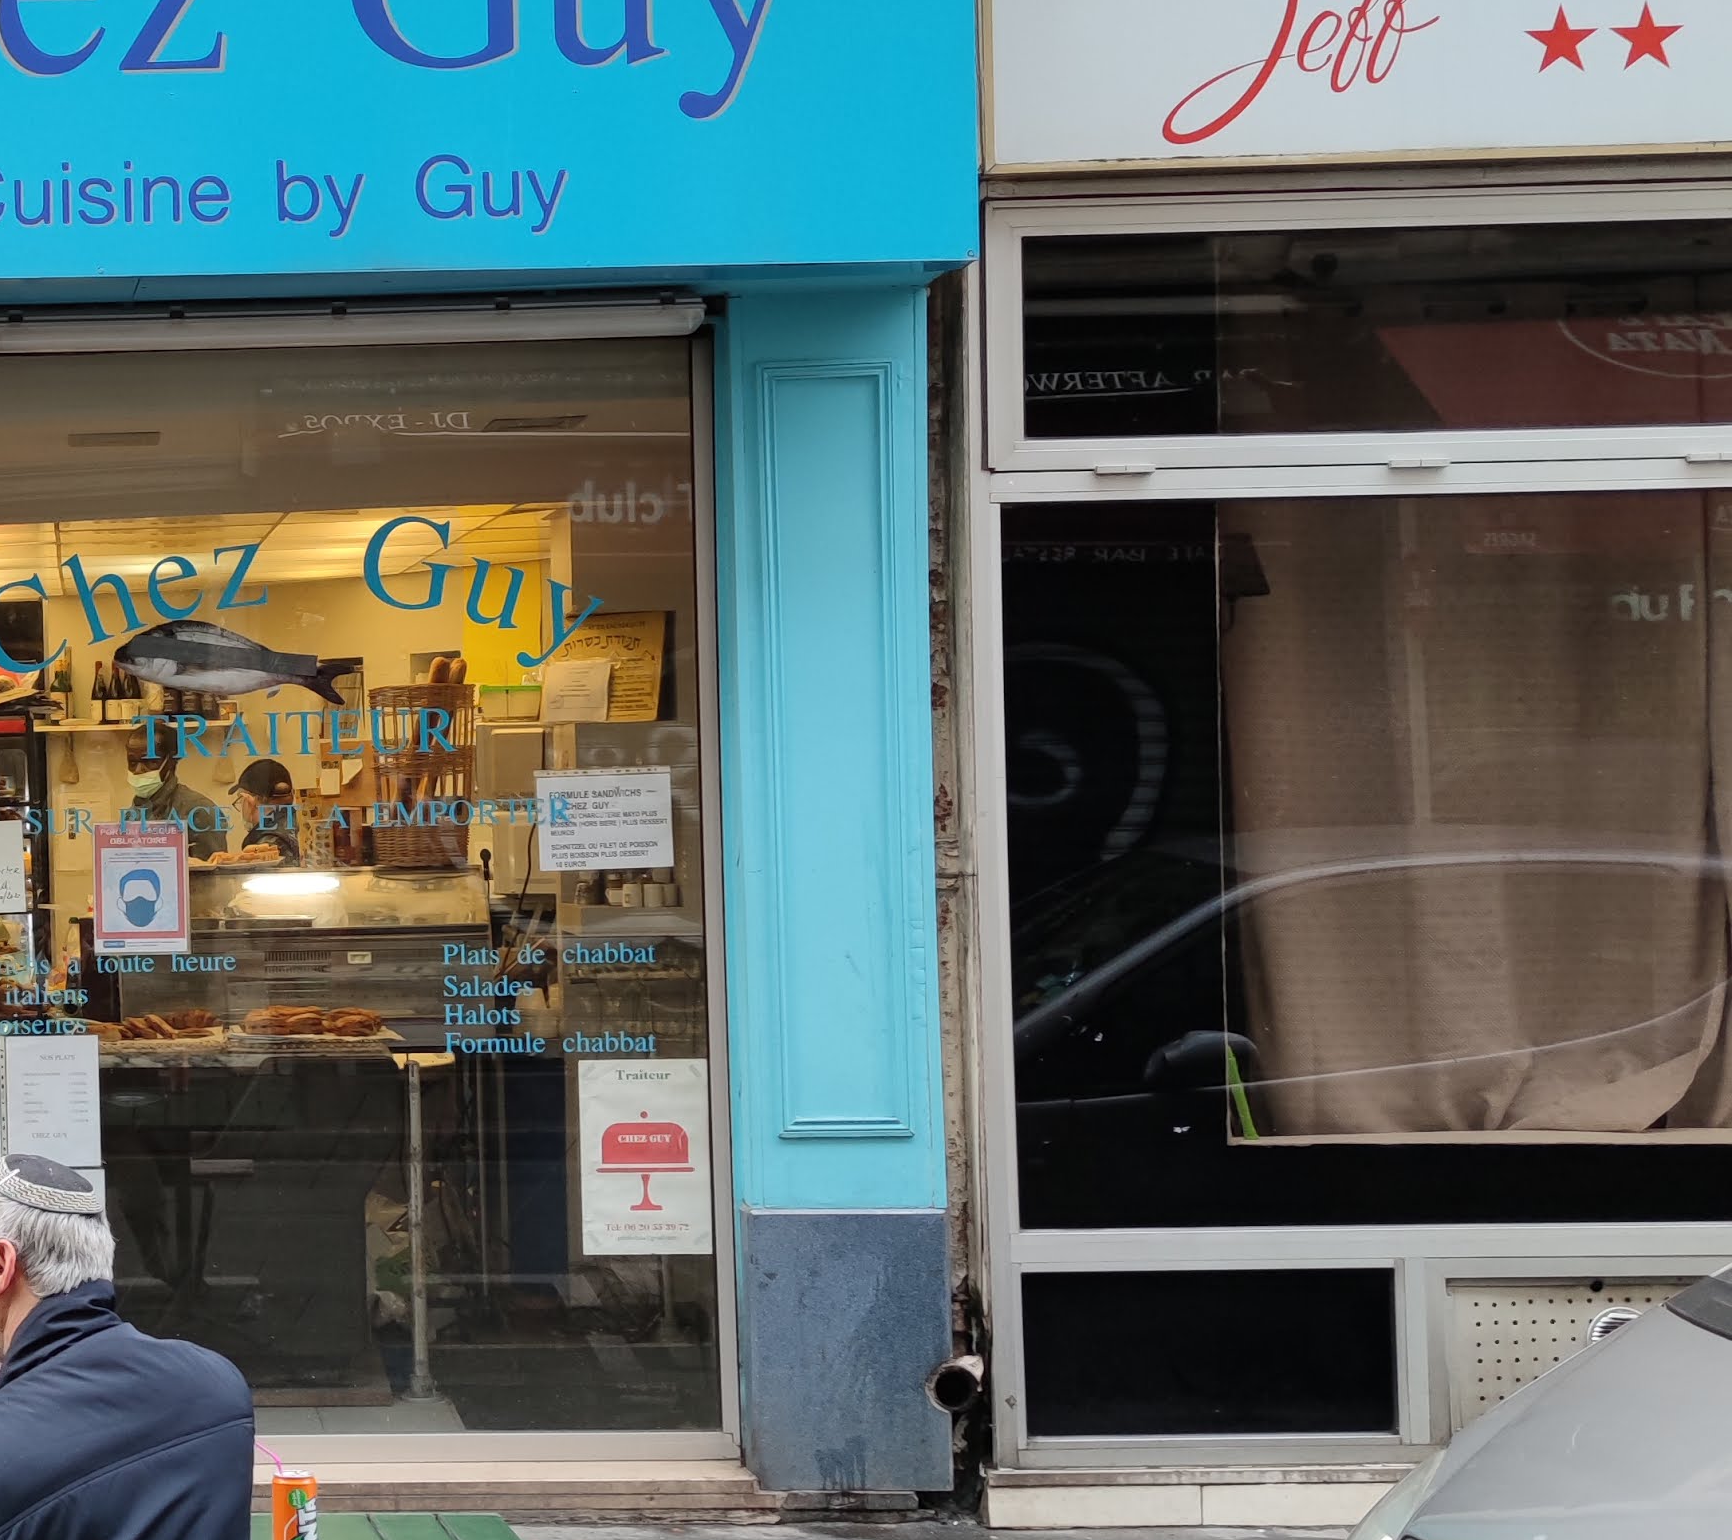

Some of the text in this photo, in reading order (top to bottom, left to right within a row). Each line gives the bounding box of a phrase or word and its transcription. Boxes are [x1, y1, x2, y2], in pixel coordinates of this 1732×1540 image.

[275, 158, 367, 238] by
[413, 152, 570, 234] Guy
[363, 515, 605, 668] Guy
[132, 707, 458, 761] TRAITEUR
[549, 790, 589, 800] FORMULE
[591, 801, 610, 810] GUY
[24, 807, 94, 838] SUR
[118, 804, 234, 833] PLACE
[257, 803, 299, 831] ET
[372, 795, 573, 828] EMPORTER
[96, 955, 156, 974] toute
[170, 952, 238, 973] heure
[442, 941, 657, 966] Plats de chabbat
[5, 985, 90, 1007] italiens
[443, 974, 534, 998] Salades
[443, 1003, 522, 1026] Halots
[444, 1030, 658, 1055] Formule chabbat
[615, 1069, 672, 1082] Traiteur
